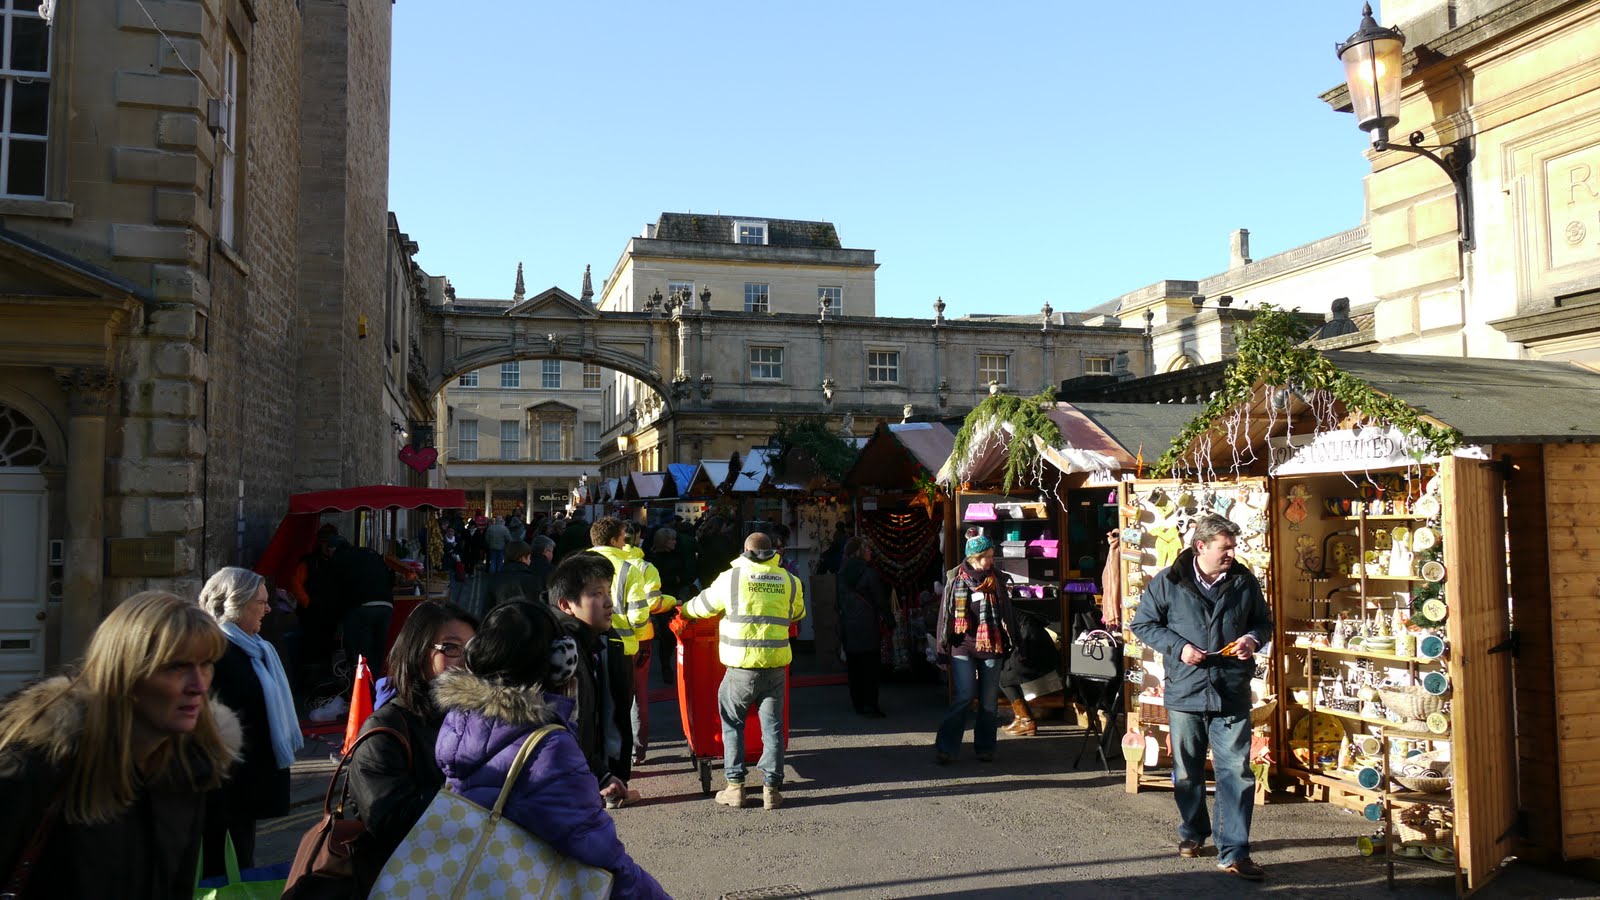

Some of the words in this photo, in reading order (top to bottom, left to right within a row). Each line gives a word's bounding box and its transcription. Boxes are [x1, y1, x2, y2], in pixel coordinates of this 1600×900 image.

[1567, 162, 1599, 207] R
[1310, 436, 1395, 463] UNLIMITED
[465, 500, 485, 509] TORE
[493, 500, 517, 509] STORE
